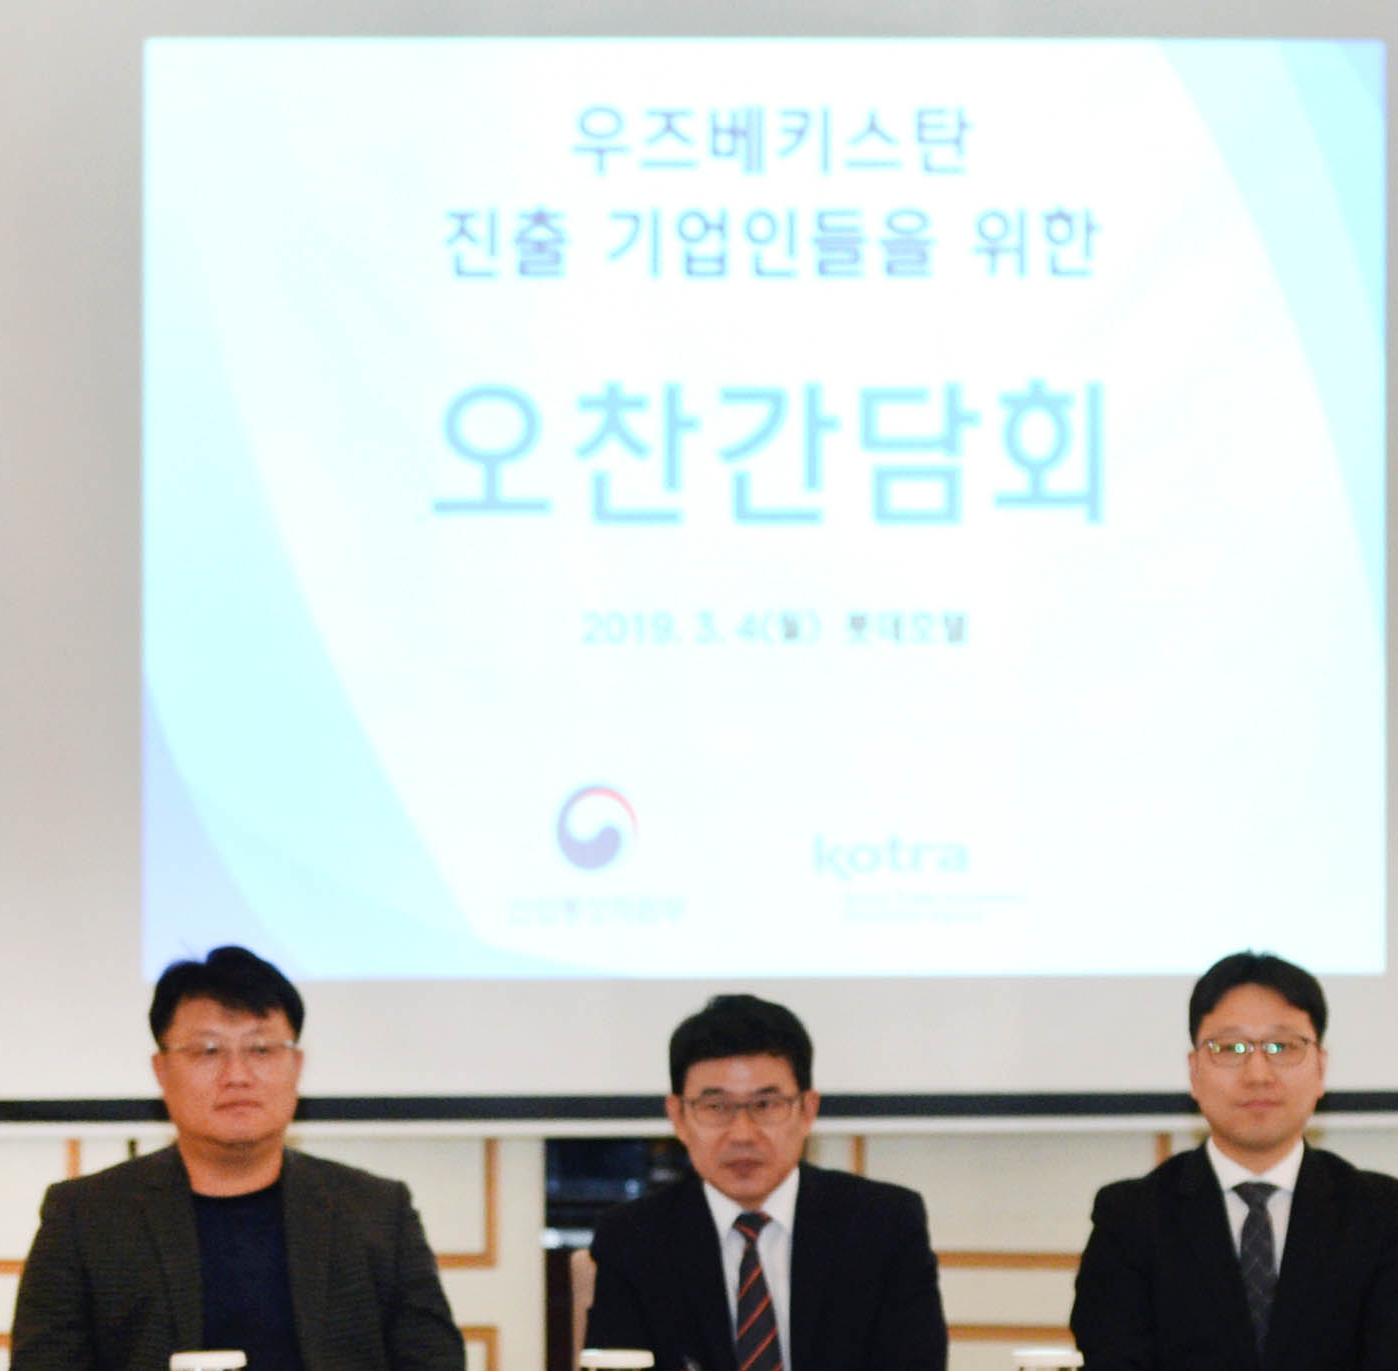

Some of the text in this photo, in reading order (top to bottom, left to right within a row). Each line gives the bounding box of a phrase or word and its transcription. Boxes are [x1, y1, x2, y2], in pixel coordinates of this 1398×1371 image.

[569, 103, 973, 177] 우즈베키스탄
[441, 202, 1103, 281] 진출 기업인들을 위한
[430, 376, 1106, 527] 오찬간담회
[810, 832, 972, 880] kotra
